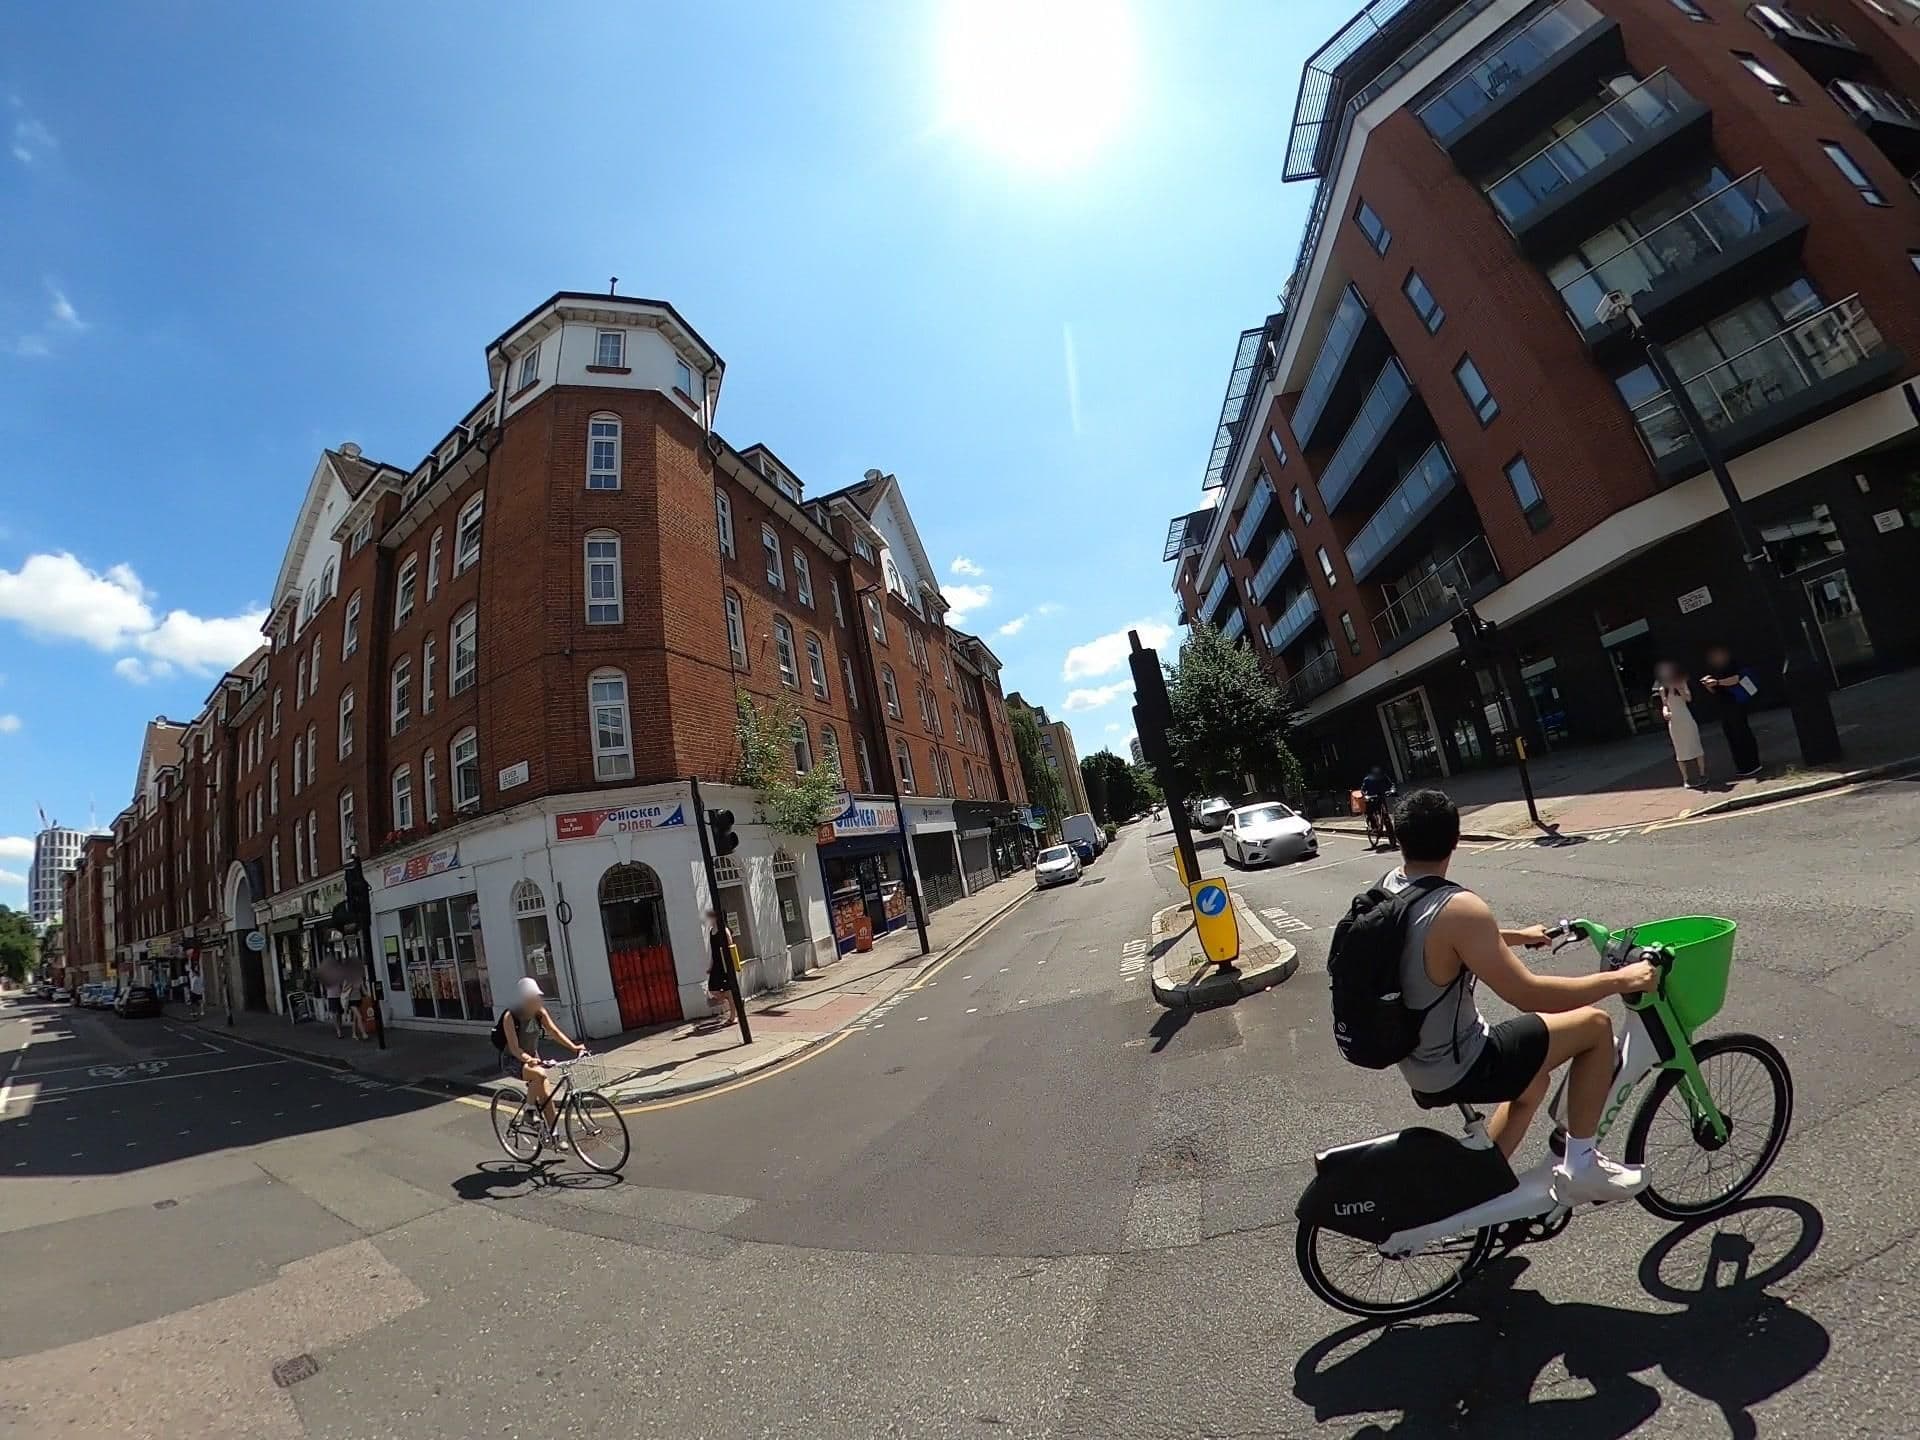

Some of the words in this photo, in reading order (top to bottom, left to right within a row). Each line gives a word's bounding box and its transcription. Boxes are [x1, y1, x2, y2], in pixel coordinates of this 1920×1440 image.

[608, 806, 661, 822] CHICKEN
[618, 818, 653, 832] DINER
[1334, 1201, 1376, 1216] Lime
